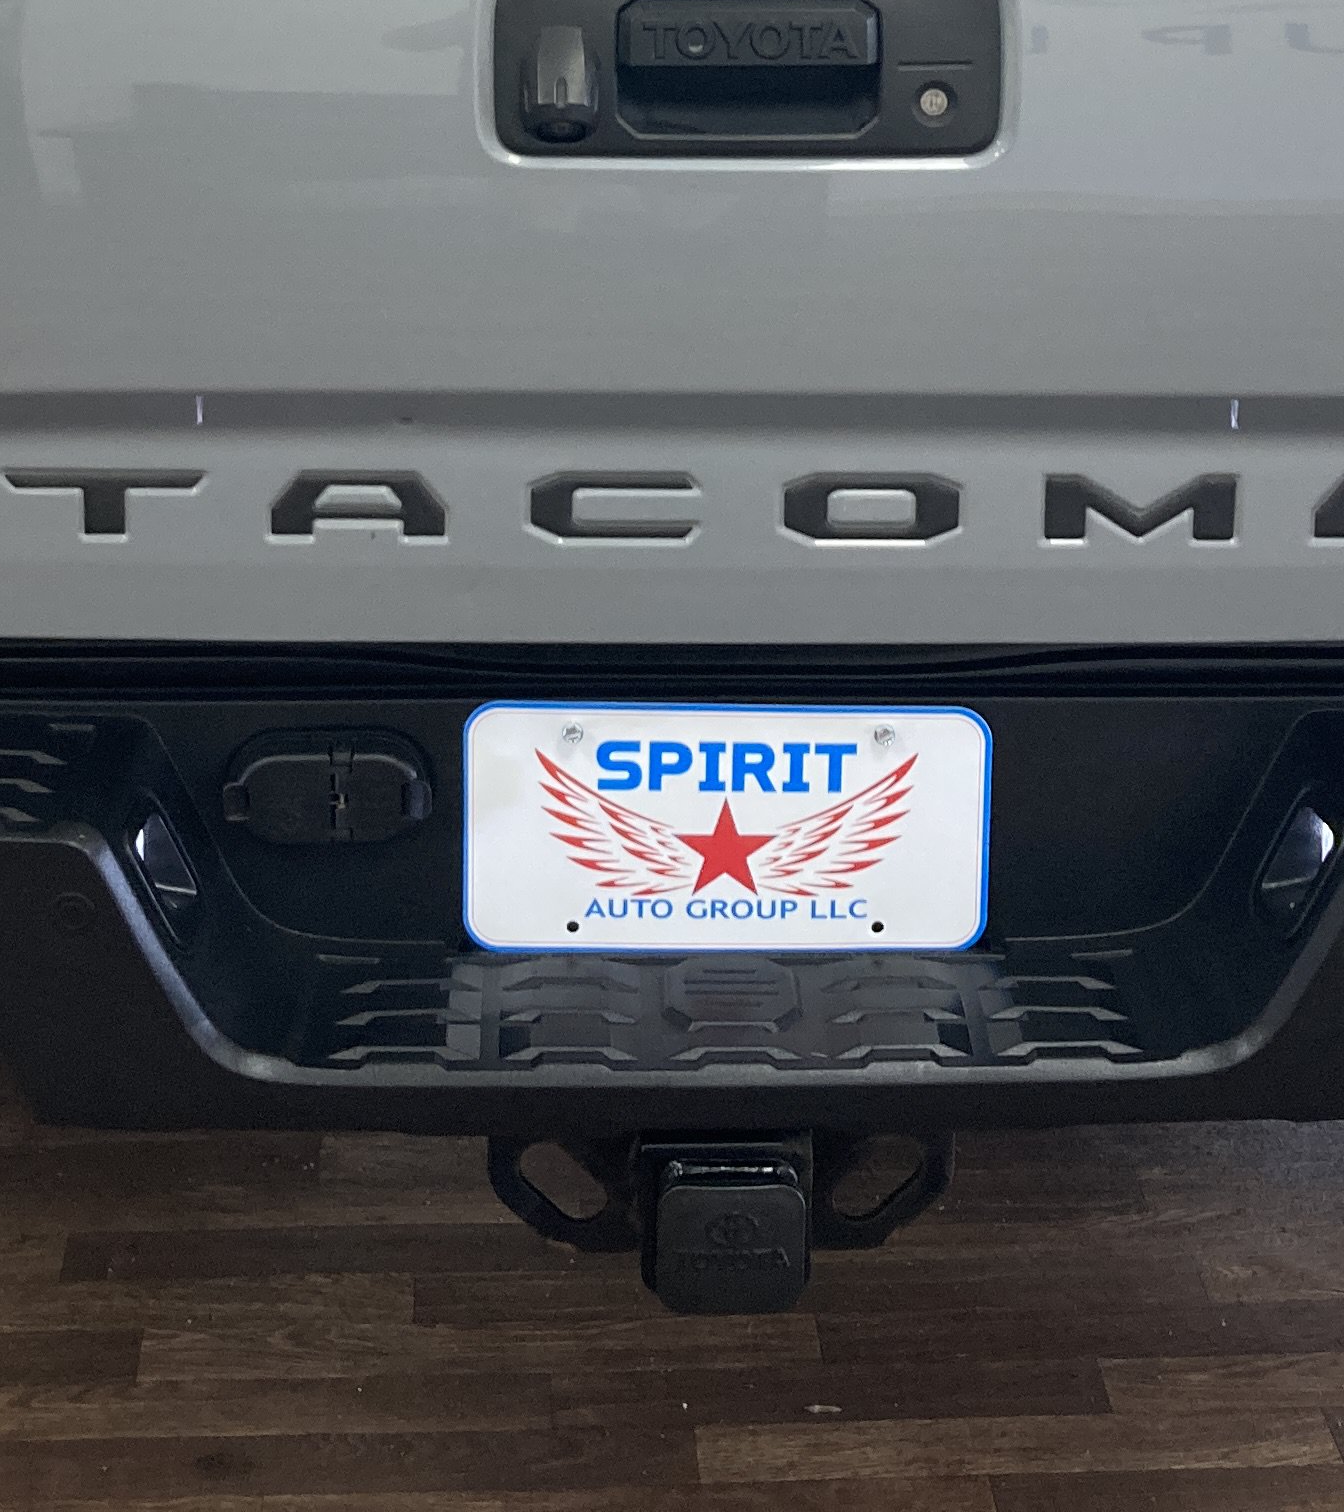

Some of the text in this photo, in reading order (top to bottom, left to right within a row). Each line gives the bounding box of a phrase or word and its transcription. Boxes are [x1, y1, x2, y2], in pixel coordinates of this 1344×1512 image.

[642, 20, 860, 61] TOYOTA
[596, 740, 858, 794] SPIRIT
[585, 898, 868, 921] AUTO GROUP LLC
